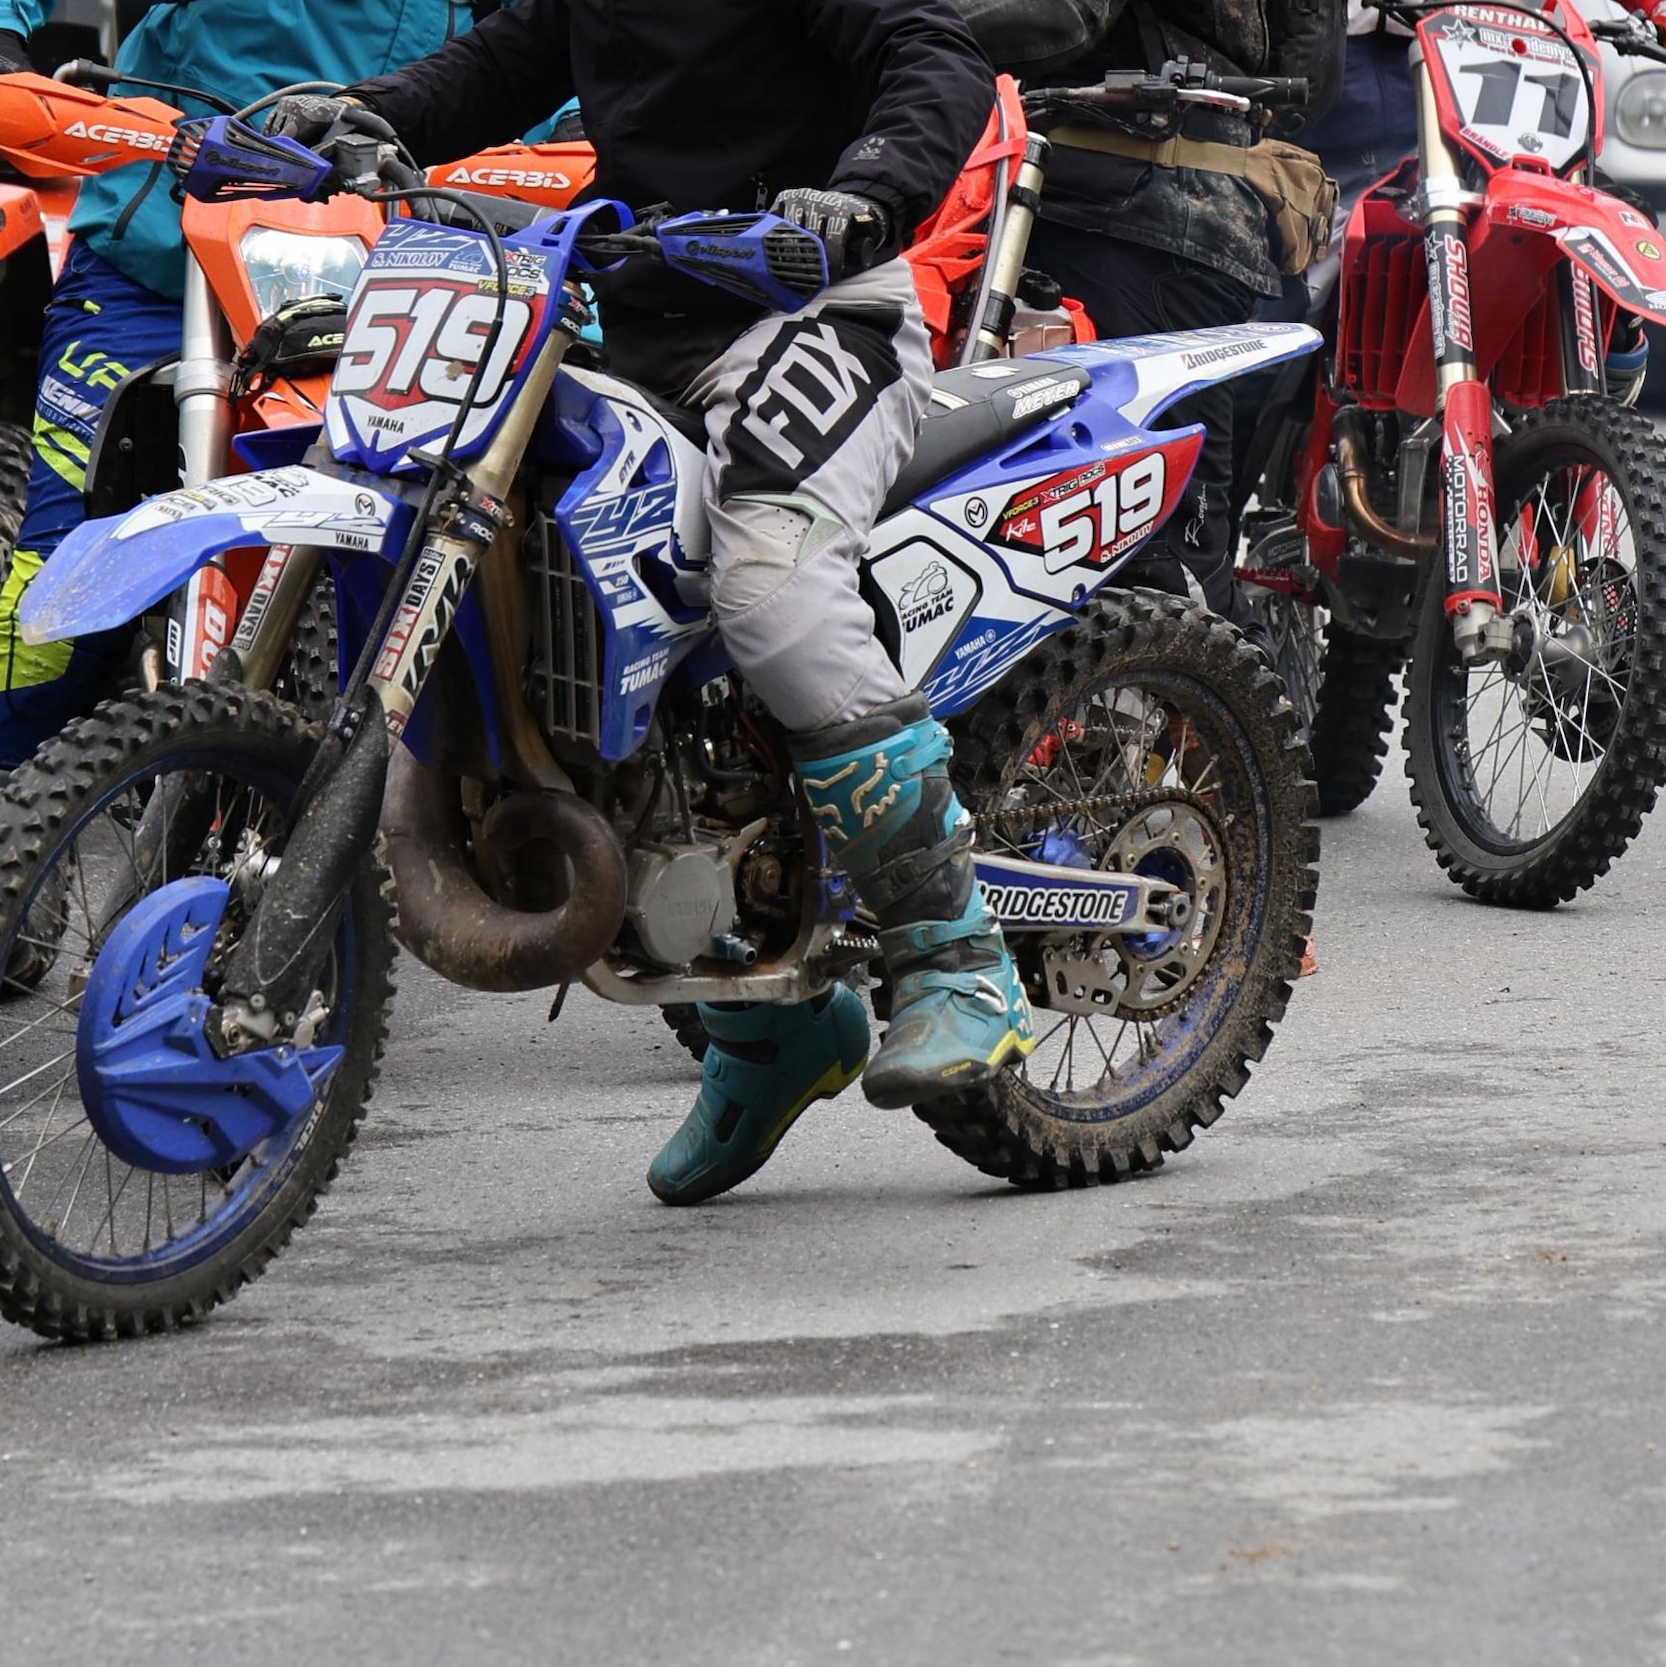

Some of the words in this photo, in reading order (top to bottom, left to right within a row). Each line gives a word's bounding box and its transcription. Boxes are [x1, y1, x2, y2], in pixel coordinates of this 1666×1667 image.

[445, 166, 572, 190] ACERBIS
[386, 252, 451, 268] NIKOLOV
[332, 287, 531, 410] 519
[1181, 339, 1268, 371] BRIDGESTONE
[741, 321, 872, 471] FOX
[1012, 380, 1082, 420] MEYER
[366, 414, 406, 435] YAMAHA
[1039, 477, 1077, 504] XTRIG
[1040, 451, 1167, 576] 519
[1452, 454, 1469, 584] MOTORRAD
[335, 531, 369, 550] YAMAHA
[1476, 485, 1493, 583] HONDA
[405, 561, 438, 609] DAYS
[900, 601, 930, 620] ACING
[930, 588, 954, 606] TEAM
[901, 597, 955, 634] UMAC
[623, 654, 651, 675] RACING
[953, 635, 988, 661] YAMAHA
[619, 658, 669, 696] TUMAC
